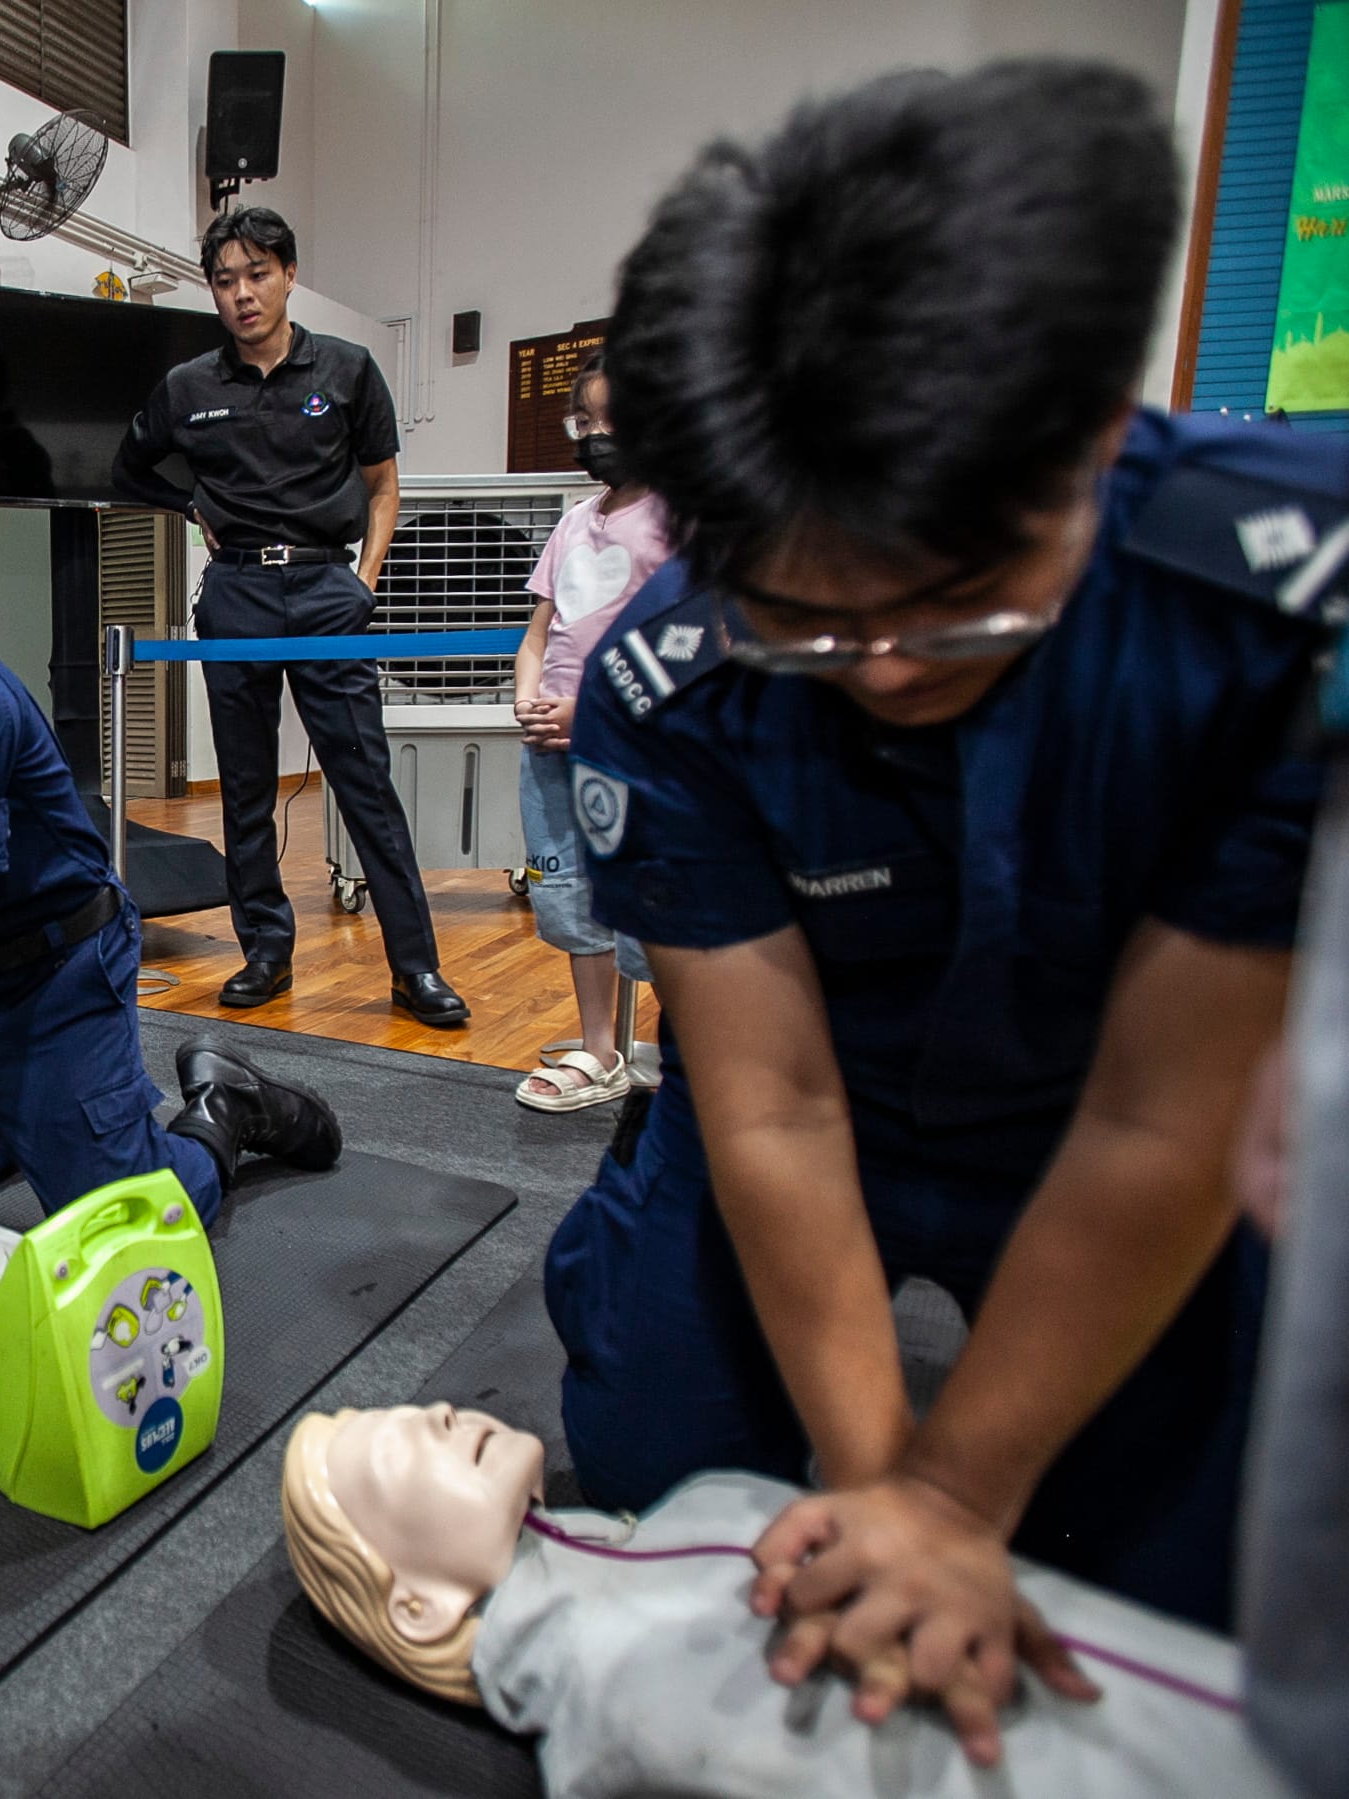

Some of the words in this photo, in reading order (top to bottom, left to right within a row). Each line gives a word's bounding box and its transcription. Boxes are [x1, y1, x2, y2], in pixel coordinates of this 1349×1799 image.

[518, 347, 535, 358] YEAR
[557, 342, 571, 352] SEC
[601, 647, 652, 716] NCDCC
